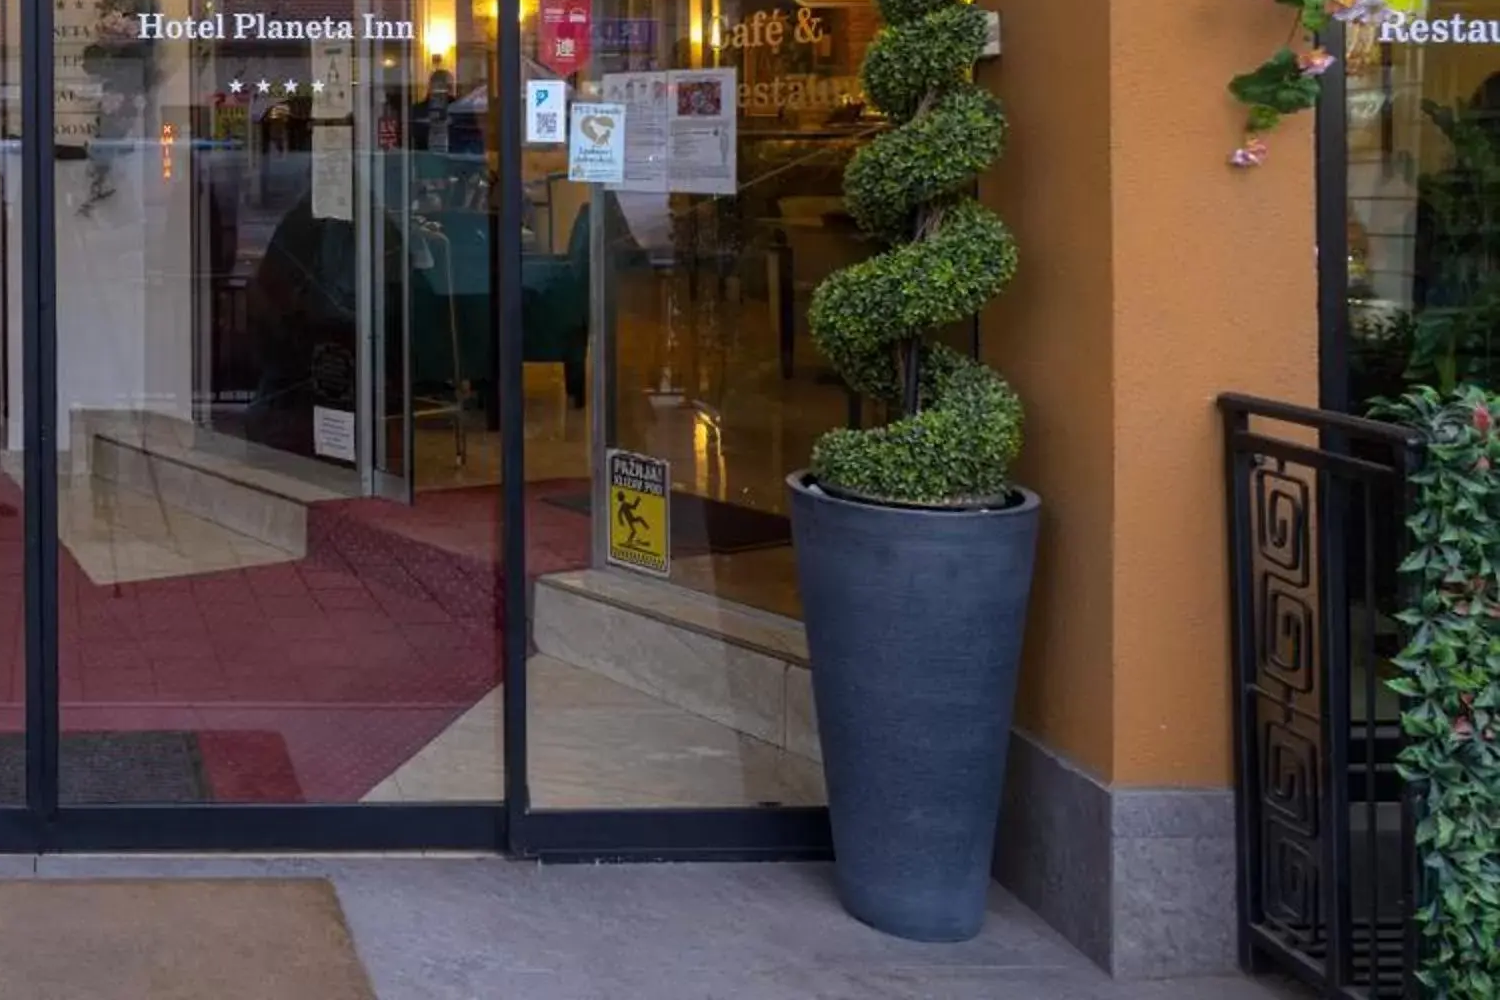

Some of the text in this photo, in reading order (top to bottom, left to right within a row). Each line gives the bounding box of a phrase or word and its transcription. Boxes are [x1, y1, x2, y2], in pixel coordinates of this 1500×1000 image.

[137, 13, 415, 40] Hotel Planeta Inn
